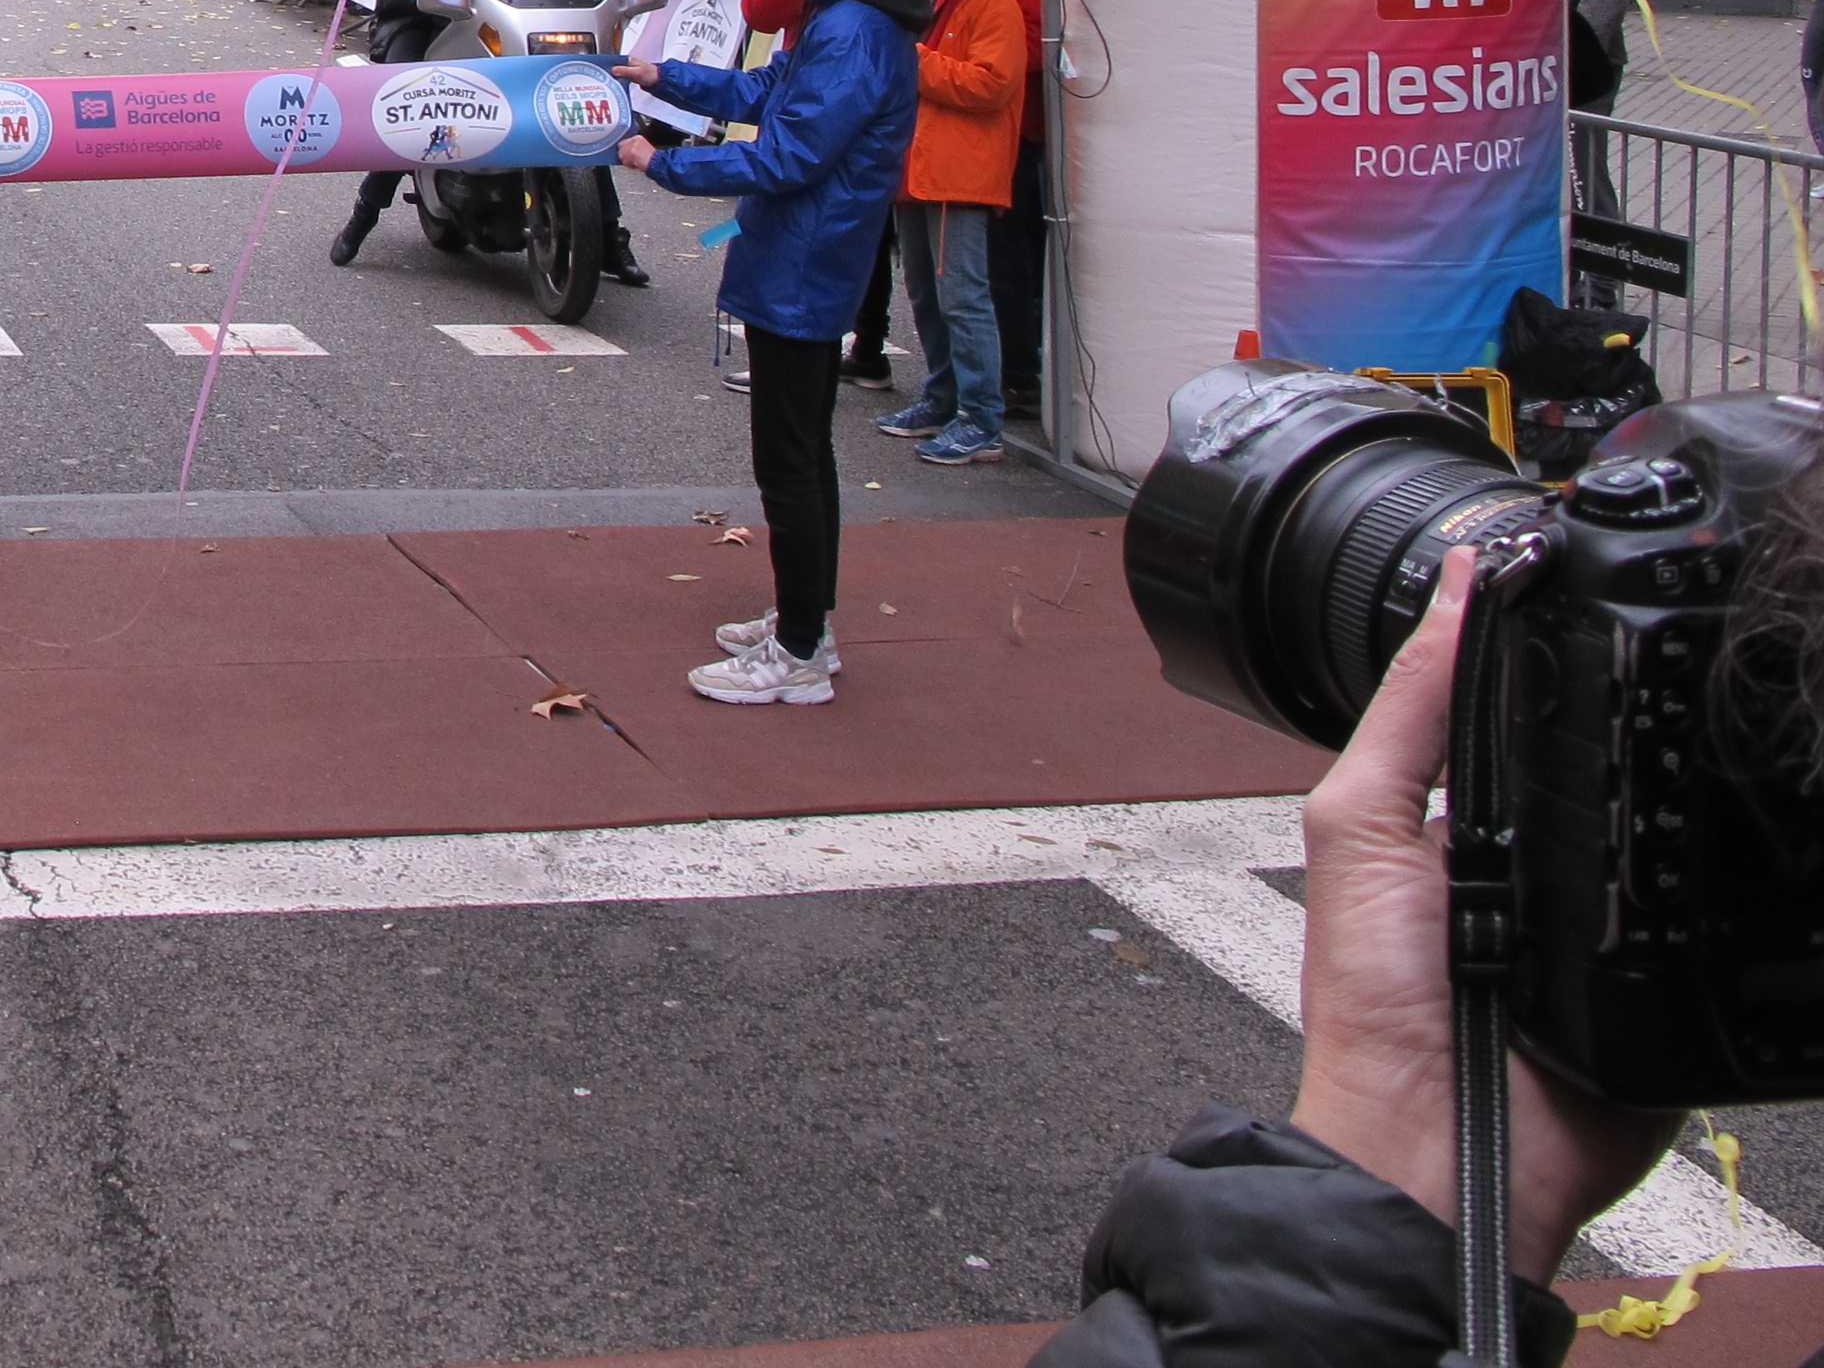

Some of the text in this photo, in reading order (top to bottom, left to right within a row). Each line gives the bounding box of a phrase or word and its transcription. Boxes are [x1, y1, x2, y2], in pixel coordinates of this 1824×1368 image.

[430, 75, 446, 86] 42
[1276, 46, 1558, 117] salesians
[125, 90, 216, 109] Aigües de
[403, 88, 477, 101] CURSA MORITZ
[128, 109, 221, 125] Barcelona
[260, 113, 330, 127] MORTZ
[386, 102, 499, 124] ST. ANTONI
[76, 137, 223, 158] La gestió responsable
[1354, 136, 1526, 178] ROCAFORT
[1622, 247, 1631, 261] de
[1631, 250, 1680, 275] Barcelona
